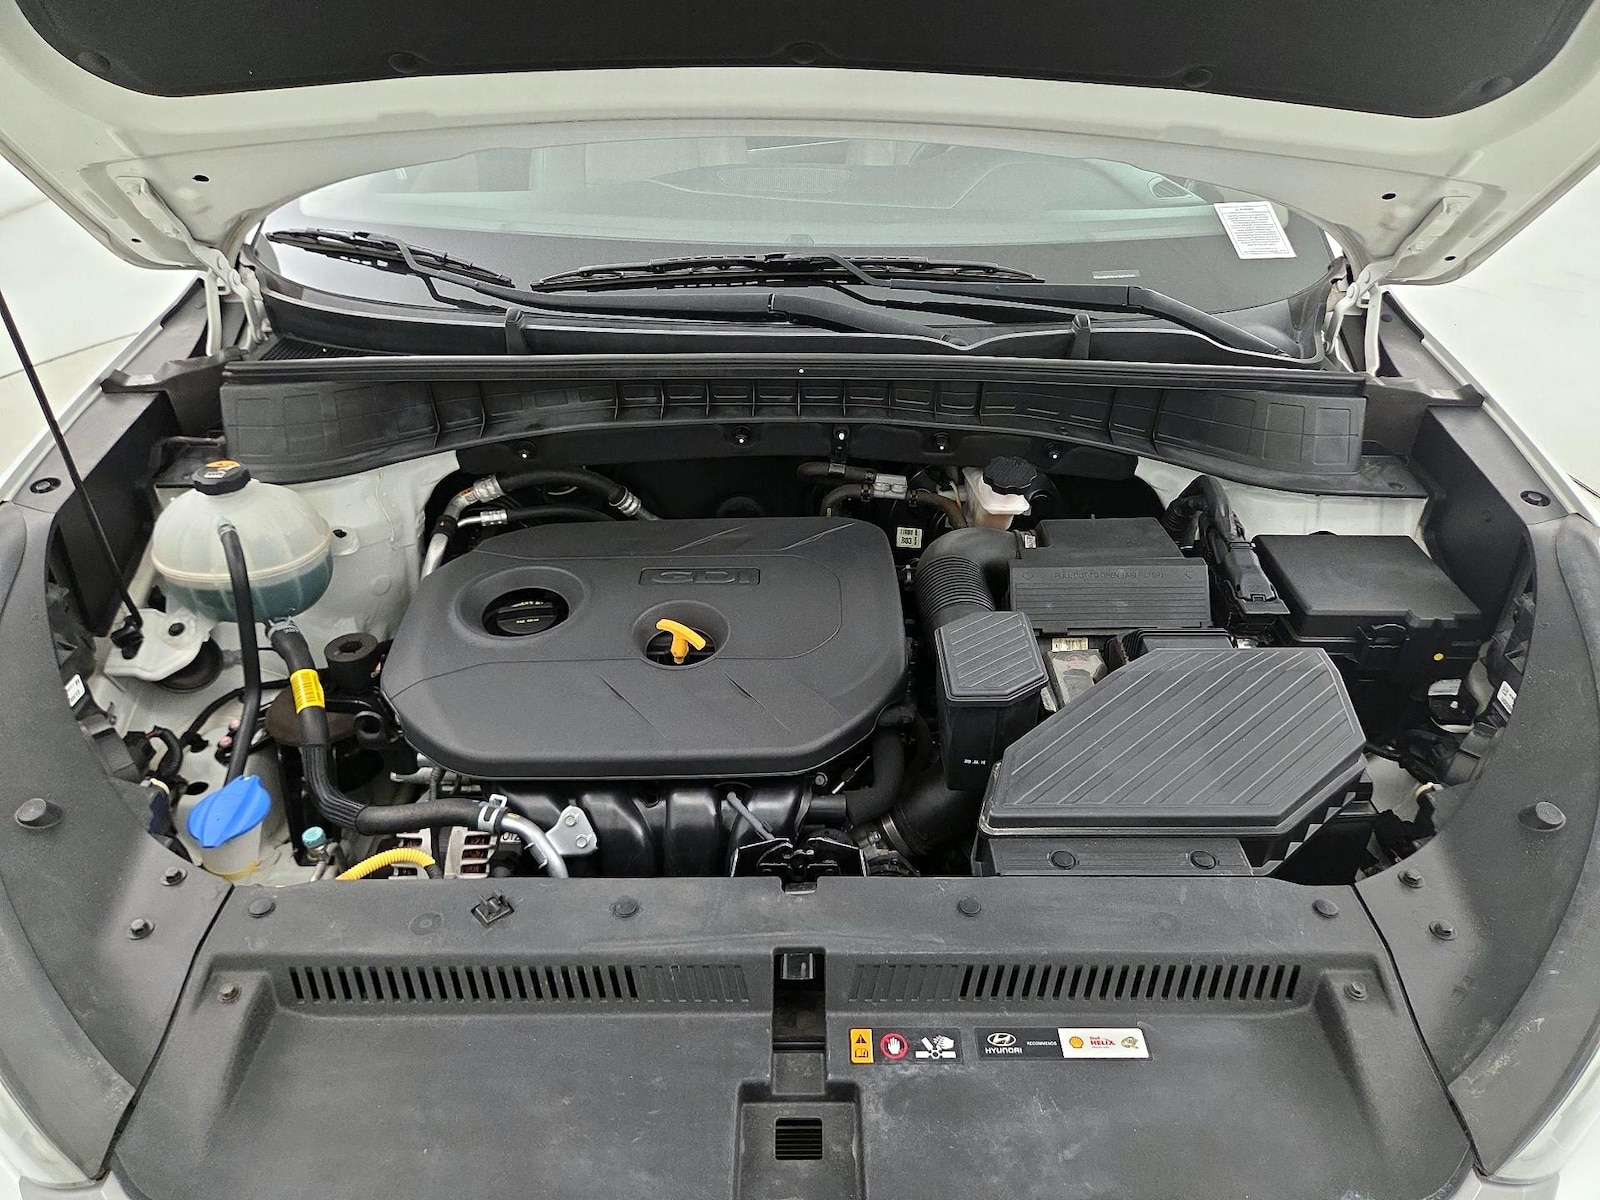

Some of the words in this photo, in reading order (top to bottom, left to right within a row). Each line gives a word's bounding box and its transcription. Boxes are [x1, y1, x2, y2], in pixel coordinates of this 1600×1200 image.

[650, 570, 752, 585] GDI
[1089, 571, 1100, 579] TO
[1101, 571, 1120, 579] OPEN
